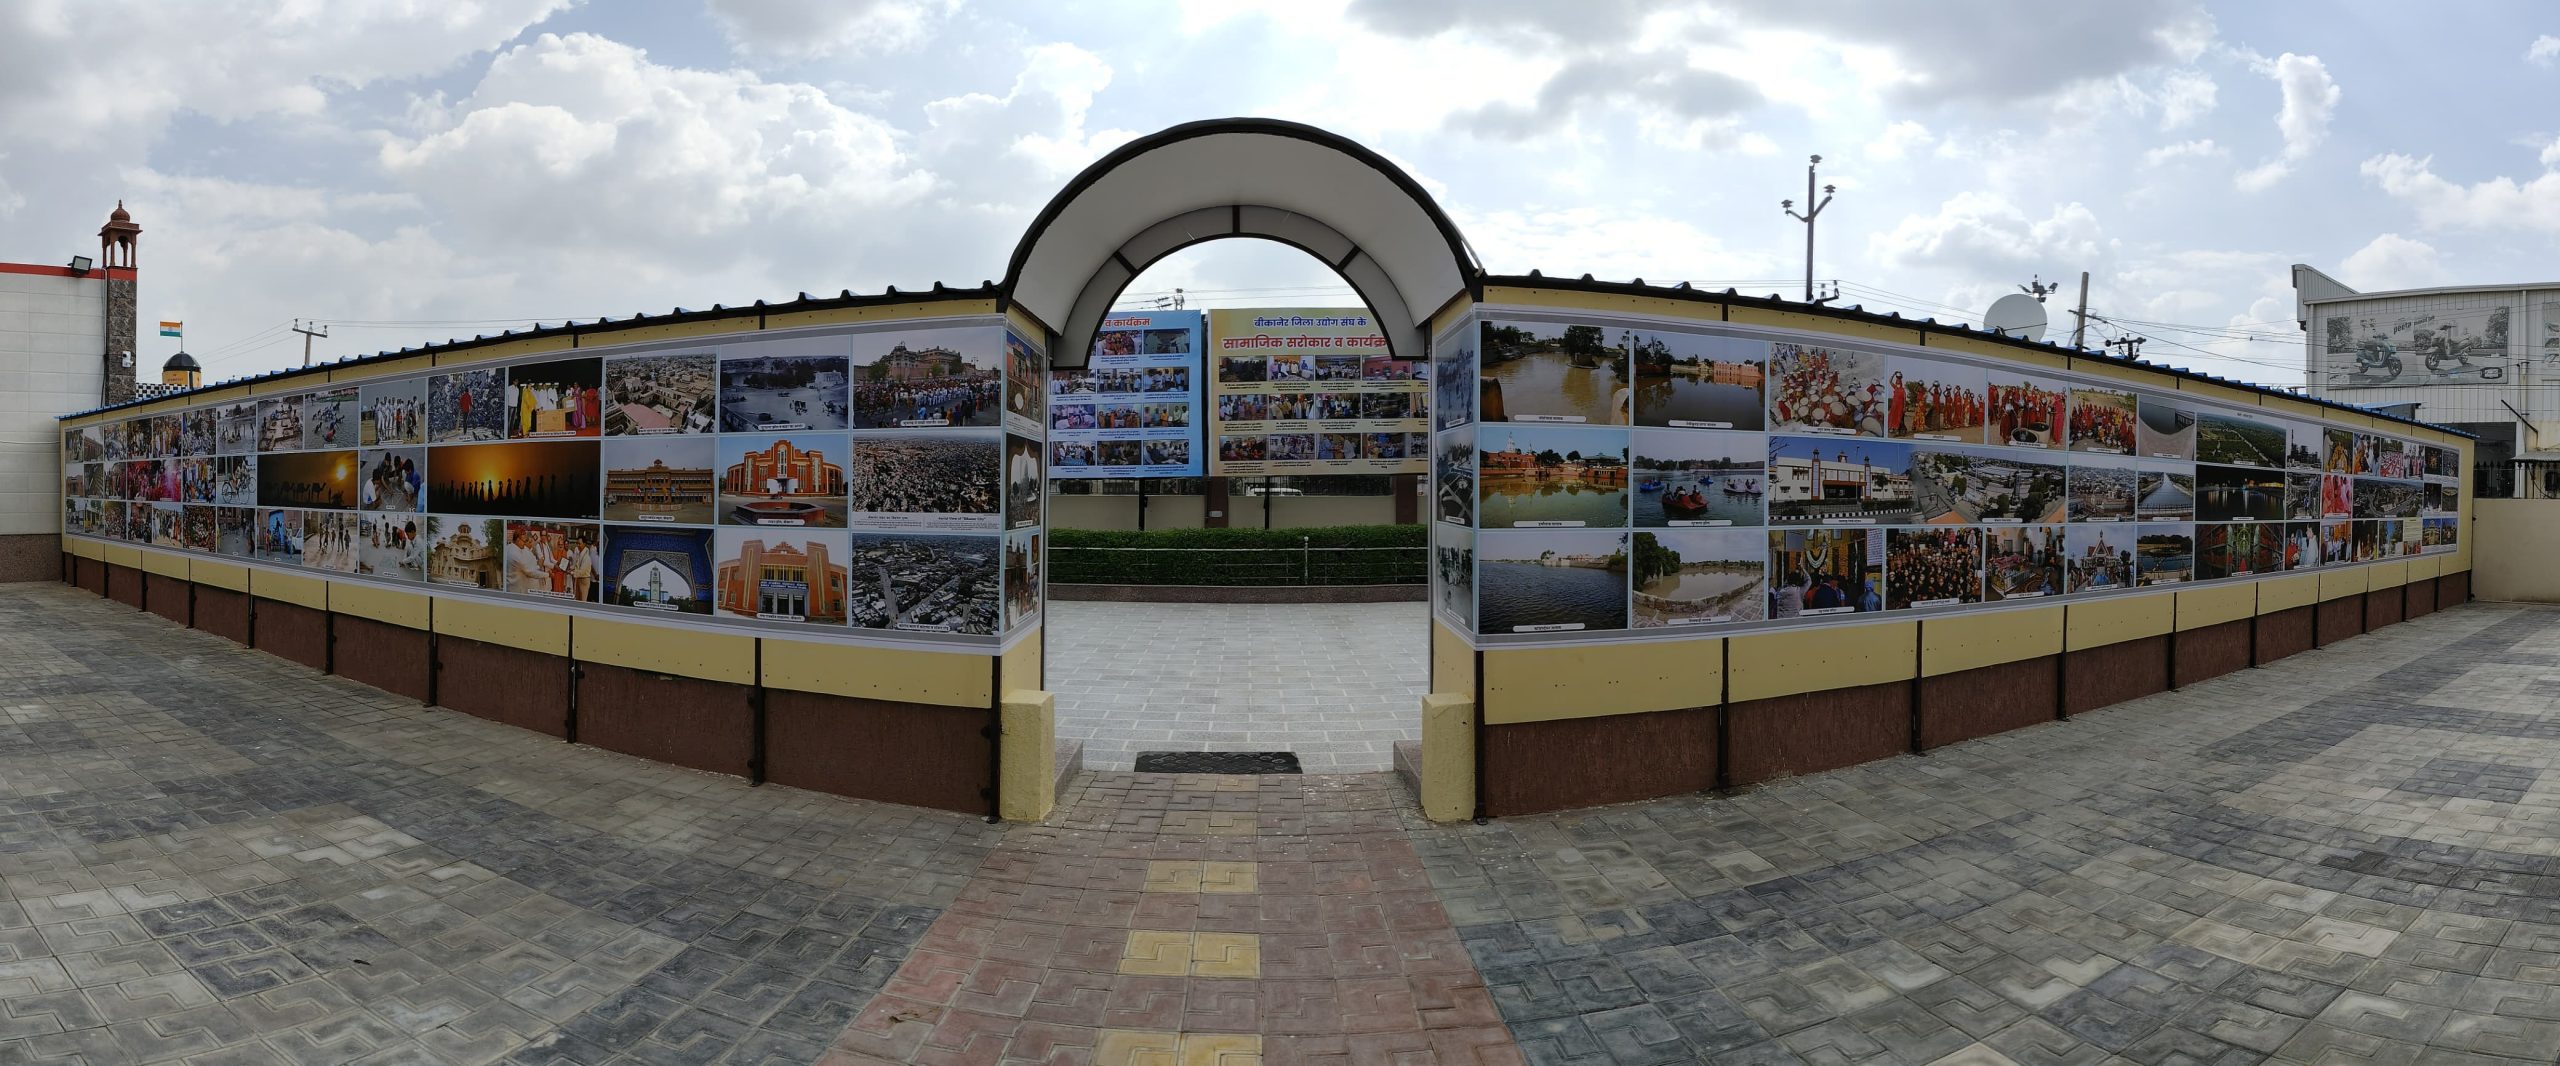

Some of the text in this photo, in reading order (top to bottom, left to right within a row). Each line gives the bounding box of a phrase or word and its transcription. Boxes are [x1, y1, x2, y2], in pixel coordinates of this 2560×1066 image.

[1104, 316, 1150, 327] व कार्यक्रम
[1254, 316, 1367, 327] बीकानेर जिला उद्योग संघ के
[1223, 334, 1387, 349] सामाजिक सरोकार व कार्यक्र
